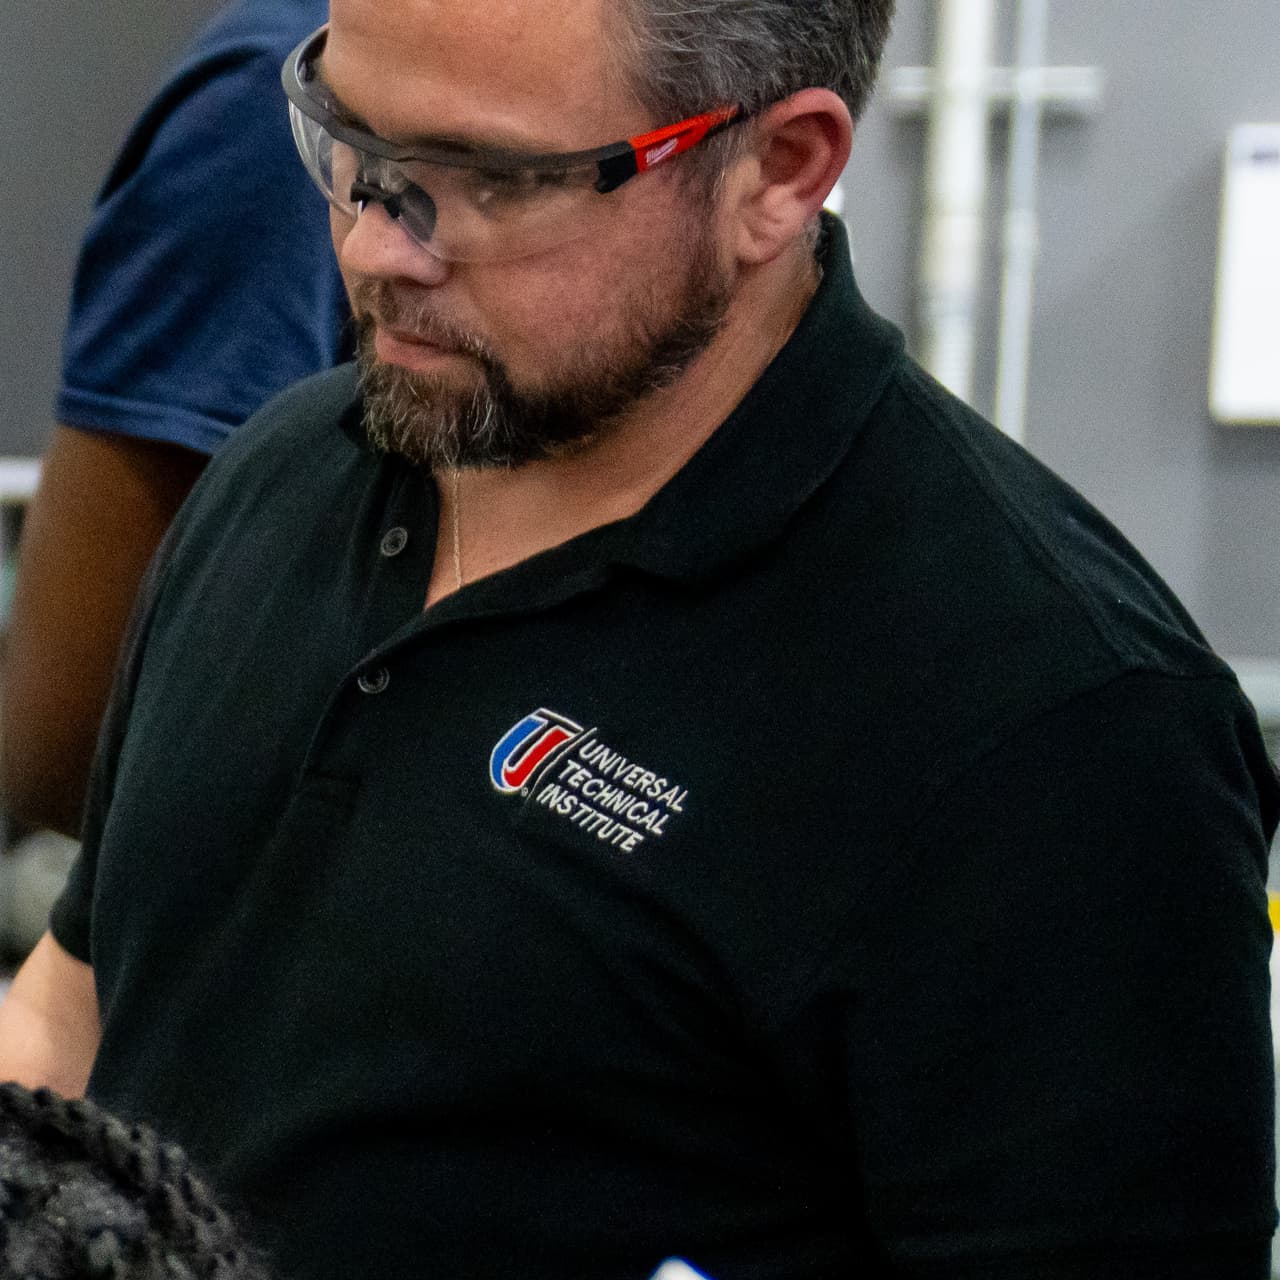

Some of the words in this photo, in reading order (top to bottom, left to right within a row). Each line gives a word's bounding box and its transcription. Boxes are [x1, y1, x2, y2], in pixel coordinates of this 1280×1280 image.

[557, 759, 670, 836] TECHNICAL
[578, 738, 690, 813] UNIVERSAL
[536, 783, 644, 852] INSTITUTE
